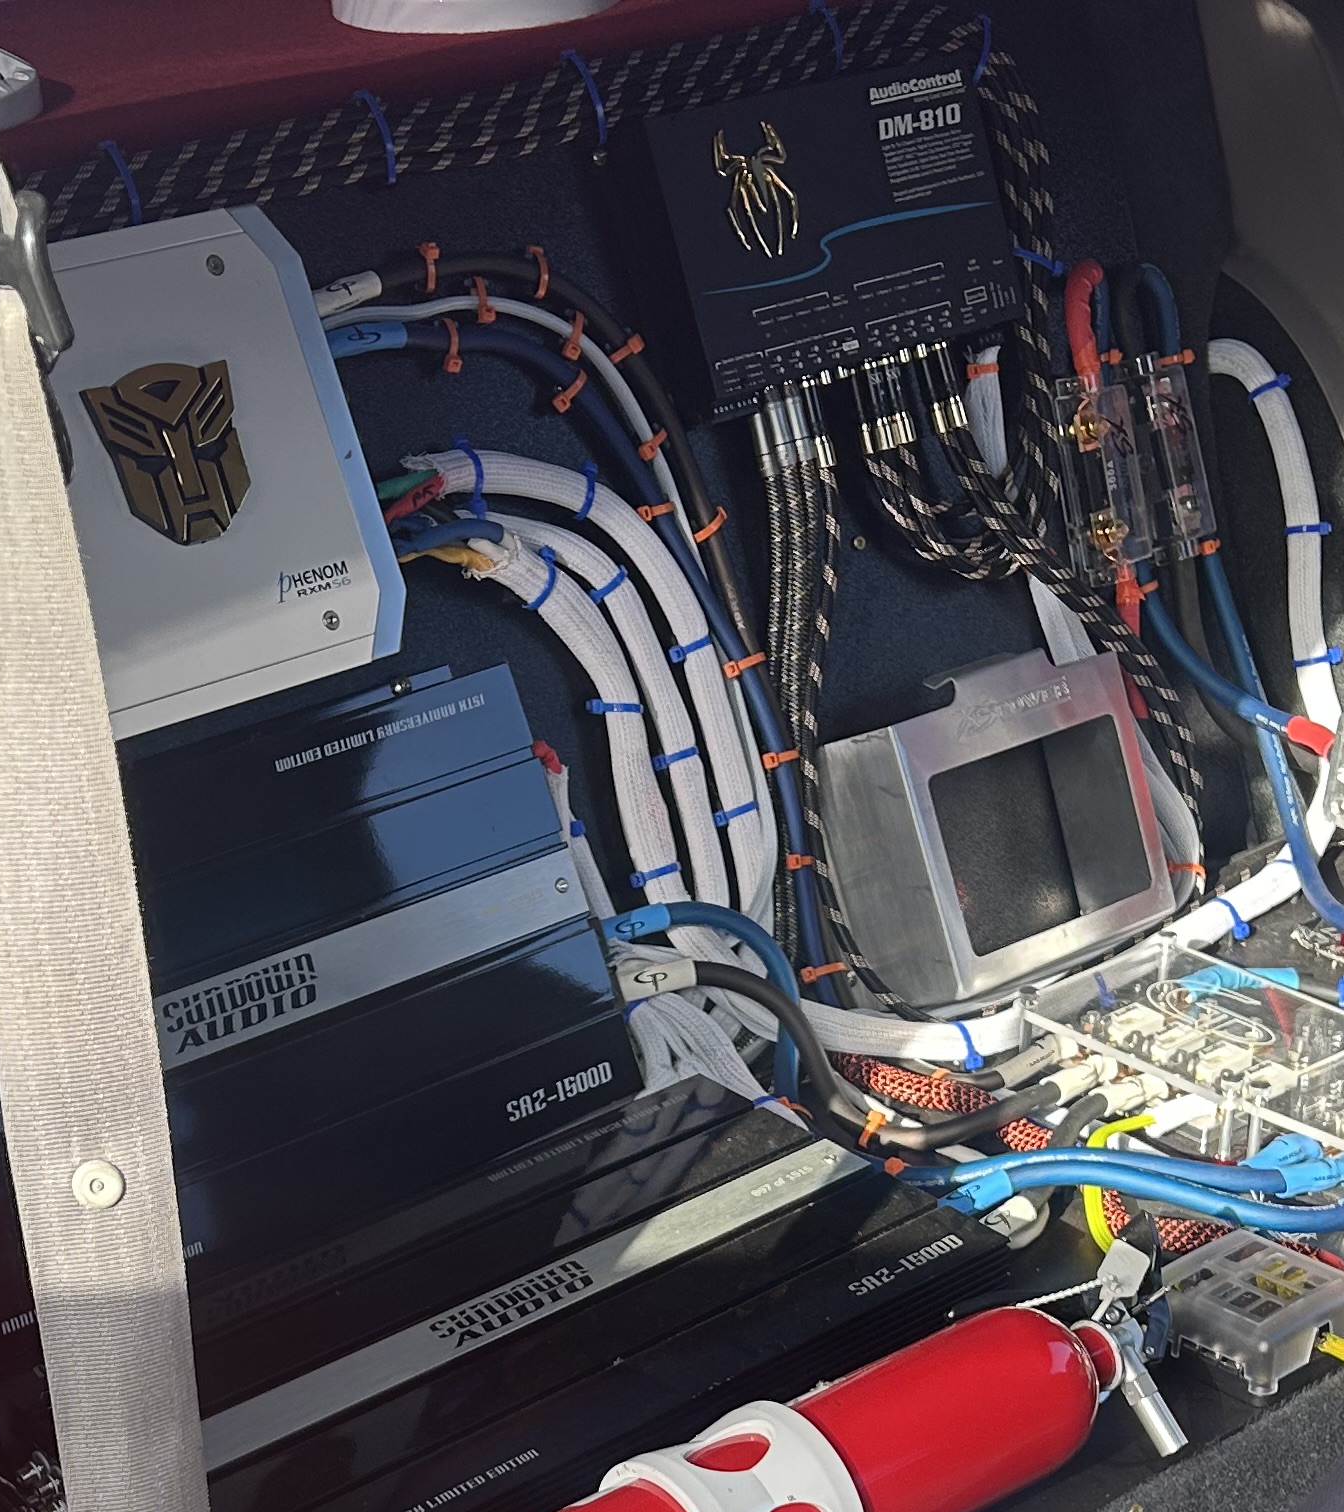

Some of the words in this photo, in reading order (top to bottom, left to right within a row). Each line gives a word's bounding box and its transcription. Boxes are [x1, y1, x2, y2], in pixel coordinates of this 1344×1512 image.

[869, 69, 963, 101] AudioControl
[878, 103, 962, 140] DM-810
[376, 702, 455, 738] ANNIVERSARY
[274, 746, 321, 772] EDITION
[323, 729, 373, 755] LIMITED
[163, 952, 318, 1033] SUNDOWN
[178, 984, 318, 1055] AUDIO
[428, 1258, 586, 1337] SUNDOWN
[454, 1278, 595, 1349] AUDIO
[0, 1309, 39, 1336] ANNI
[425, 1473, 487, 1510] LIMITED
[485, 1447, 540, 1481] EDITION
